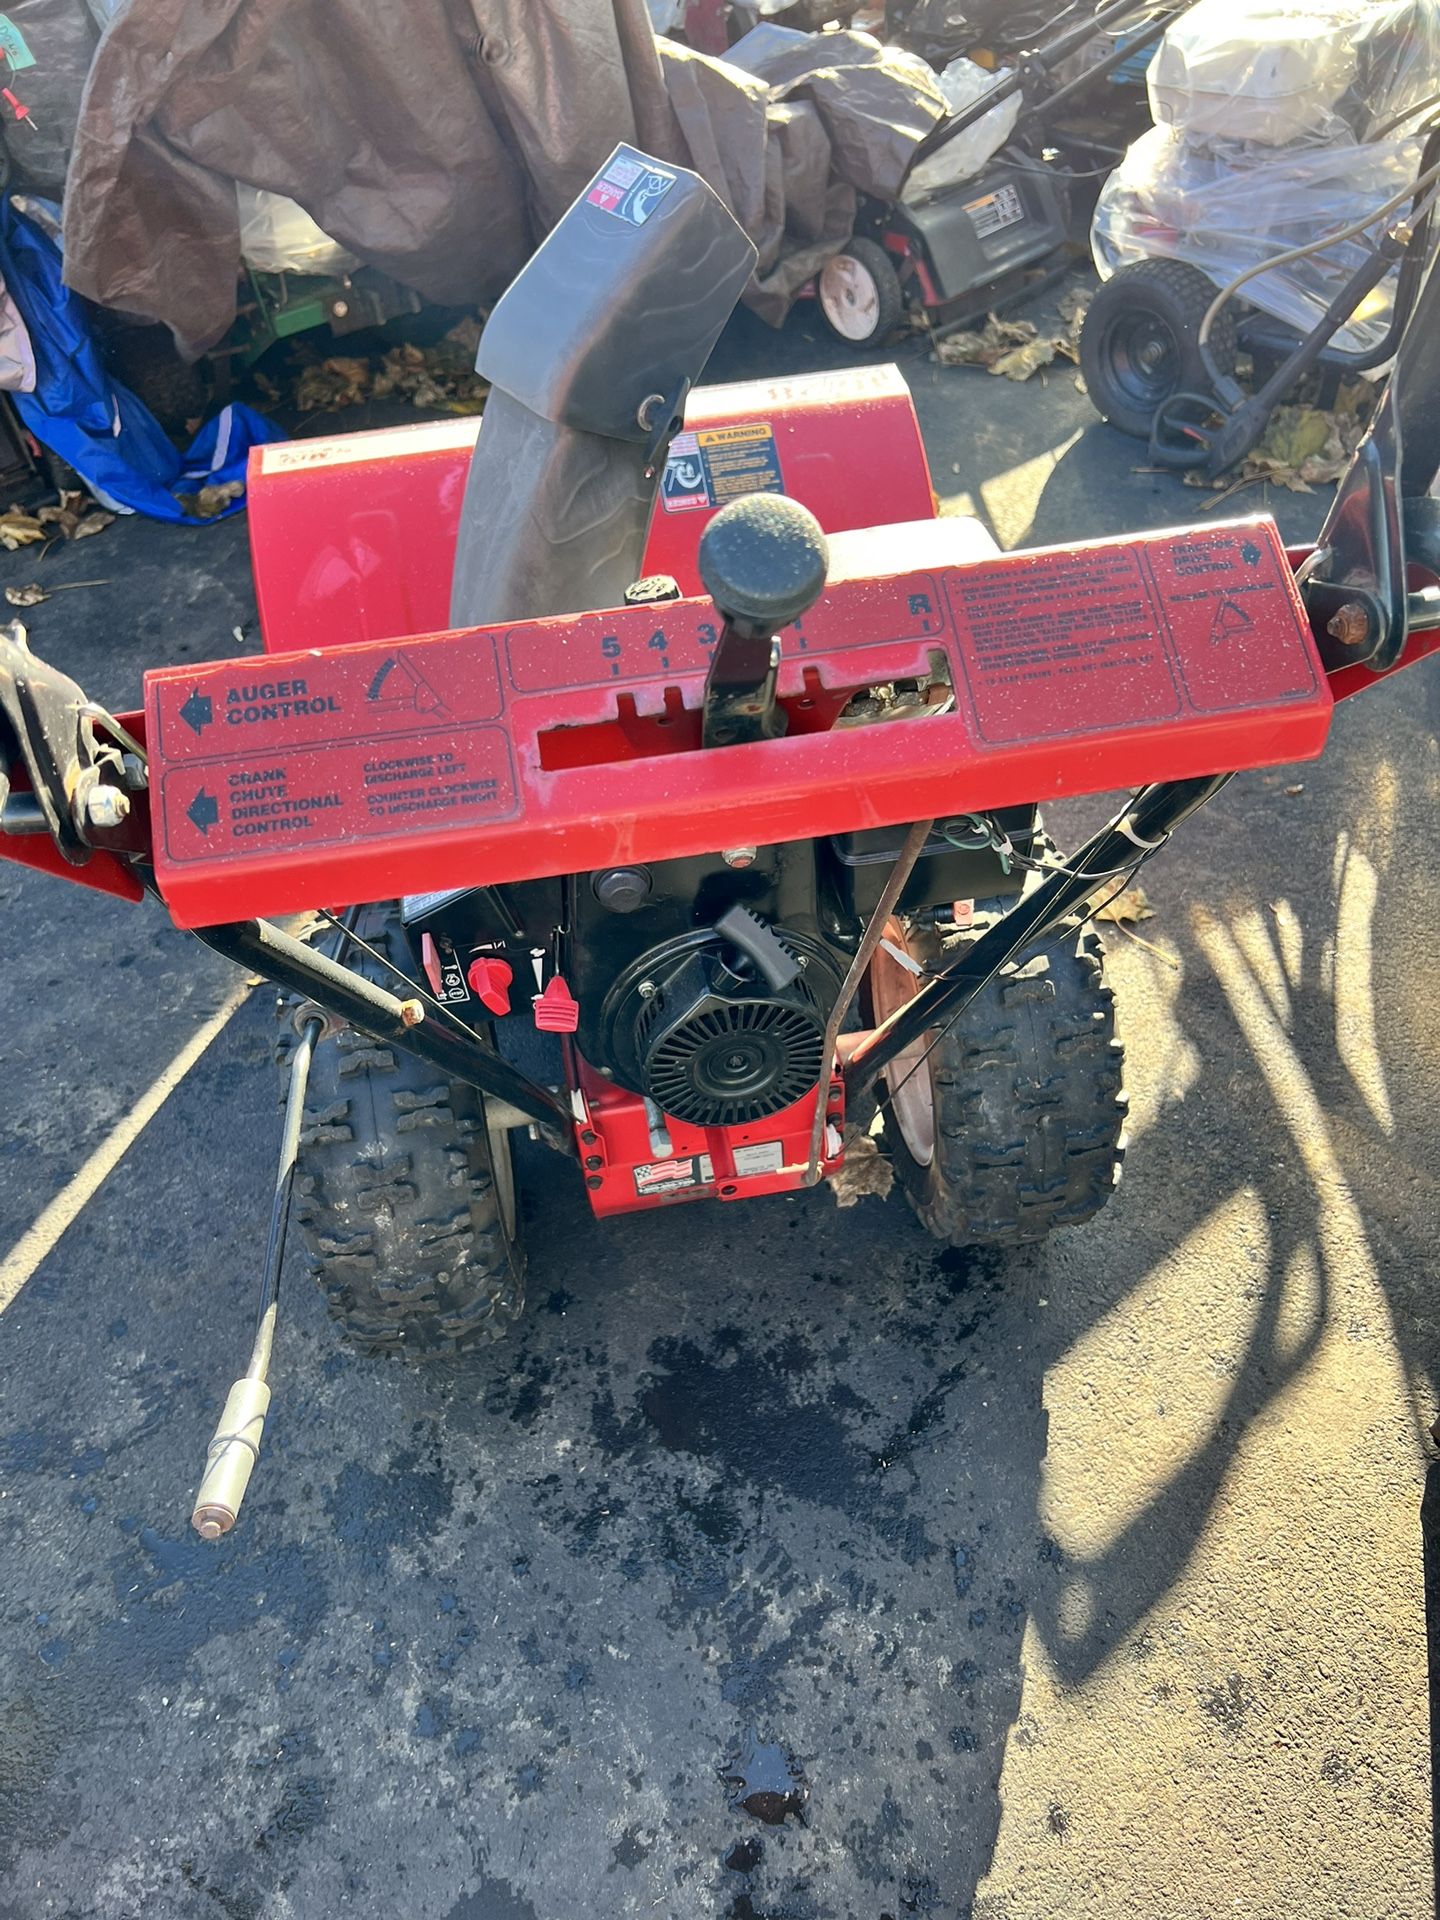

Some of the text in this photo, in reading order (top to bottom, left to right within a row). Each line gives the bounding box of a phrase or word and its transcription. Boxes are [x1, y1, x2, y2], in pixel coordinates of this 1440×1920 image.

[717, 428, 767, 440] WARNING
[602, 593, 932, 658] 5 4 3 R
[227, 679, 308, 704] AUGER
[227, 697, 341, 724] CONTROL
[363, 752, 453, 773] CLOCKWISE TO
[228, 767, 286, 786] CRANK
[365, 763, 465, 785] DISCHARGE LEFT
[230, 784, 287, 803] CHUTE
[231, 794, 343, 820] DIRECTIONAL
[233, 815, 312, 837] CONTROL
